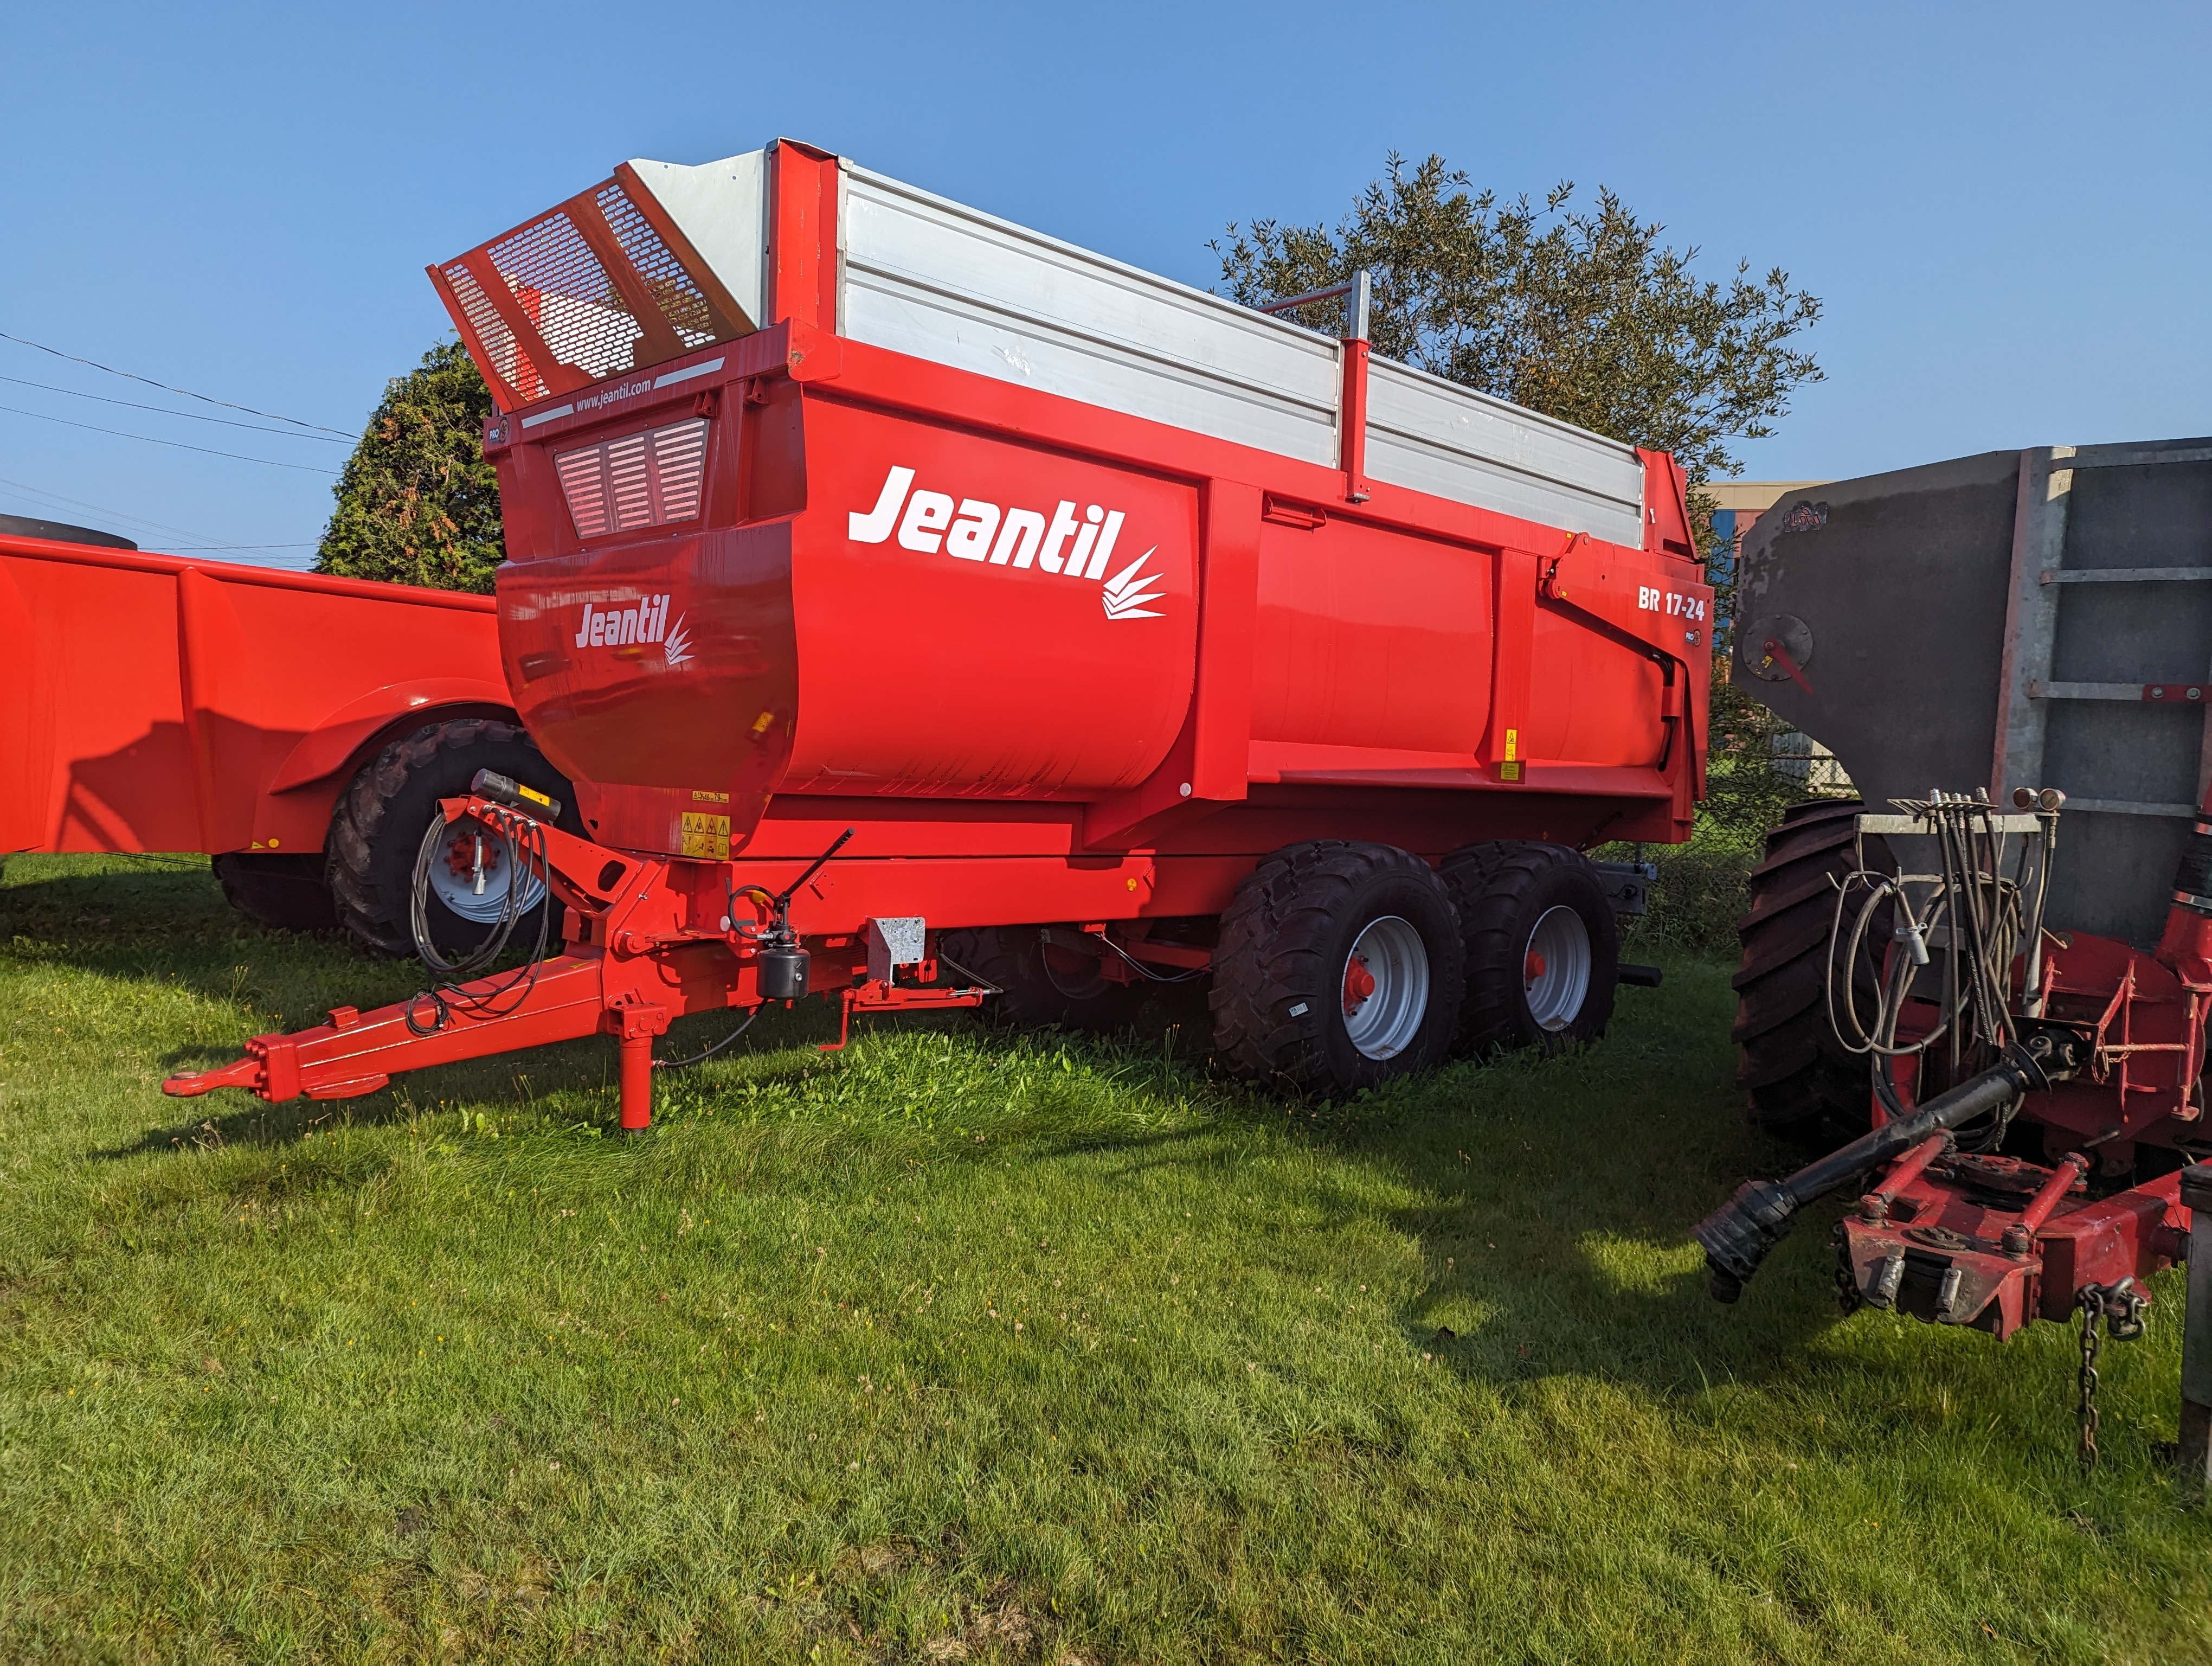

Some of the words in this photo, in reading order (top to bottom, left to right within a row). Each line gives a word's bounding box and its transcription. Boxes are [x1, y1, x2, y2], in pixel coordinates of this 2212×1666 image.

[576, 379, 651, 412] www.jeantil.com
[489, 428, 499, 440] PRO
[848, 465, 1126, 580] Jeantil
[575, 594, 671, 648] Jeantil
[1638, 585, 1661, 612] BR
[1665, 592, 1705, 622] 17-24
